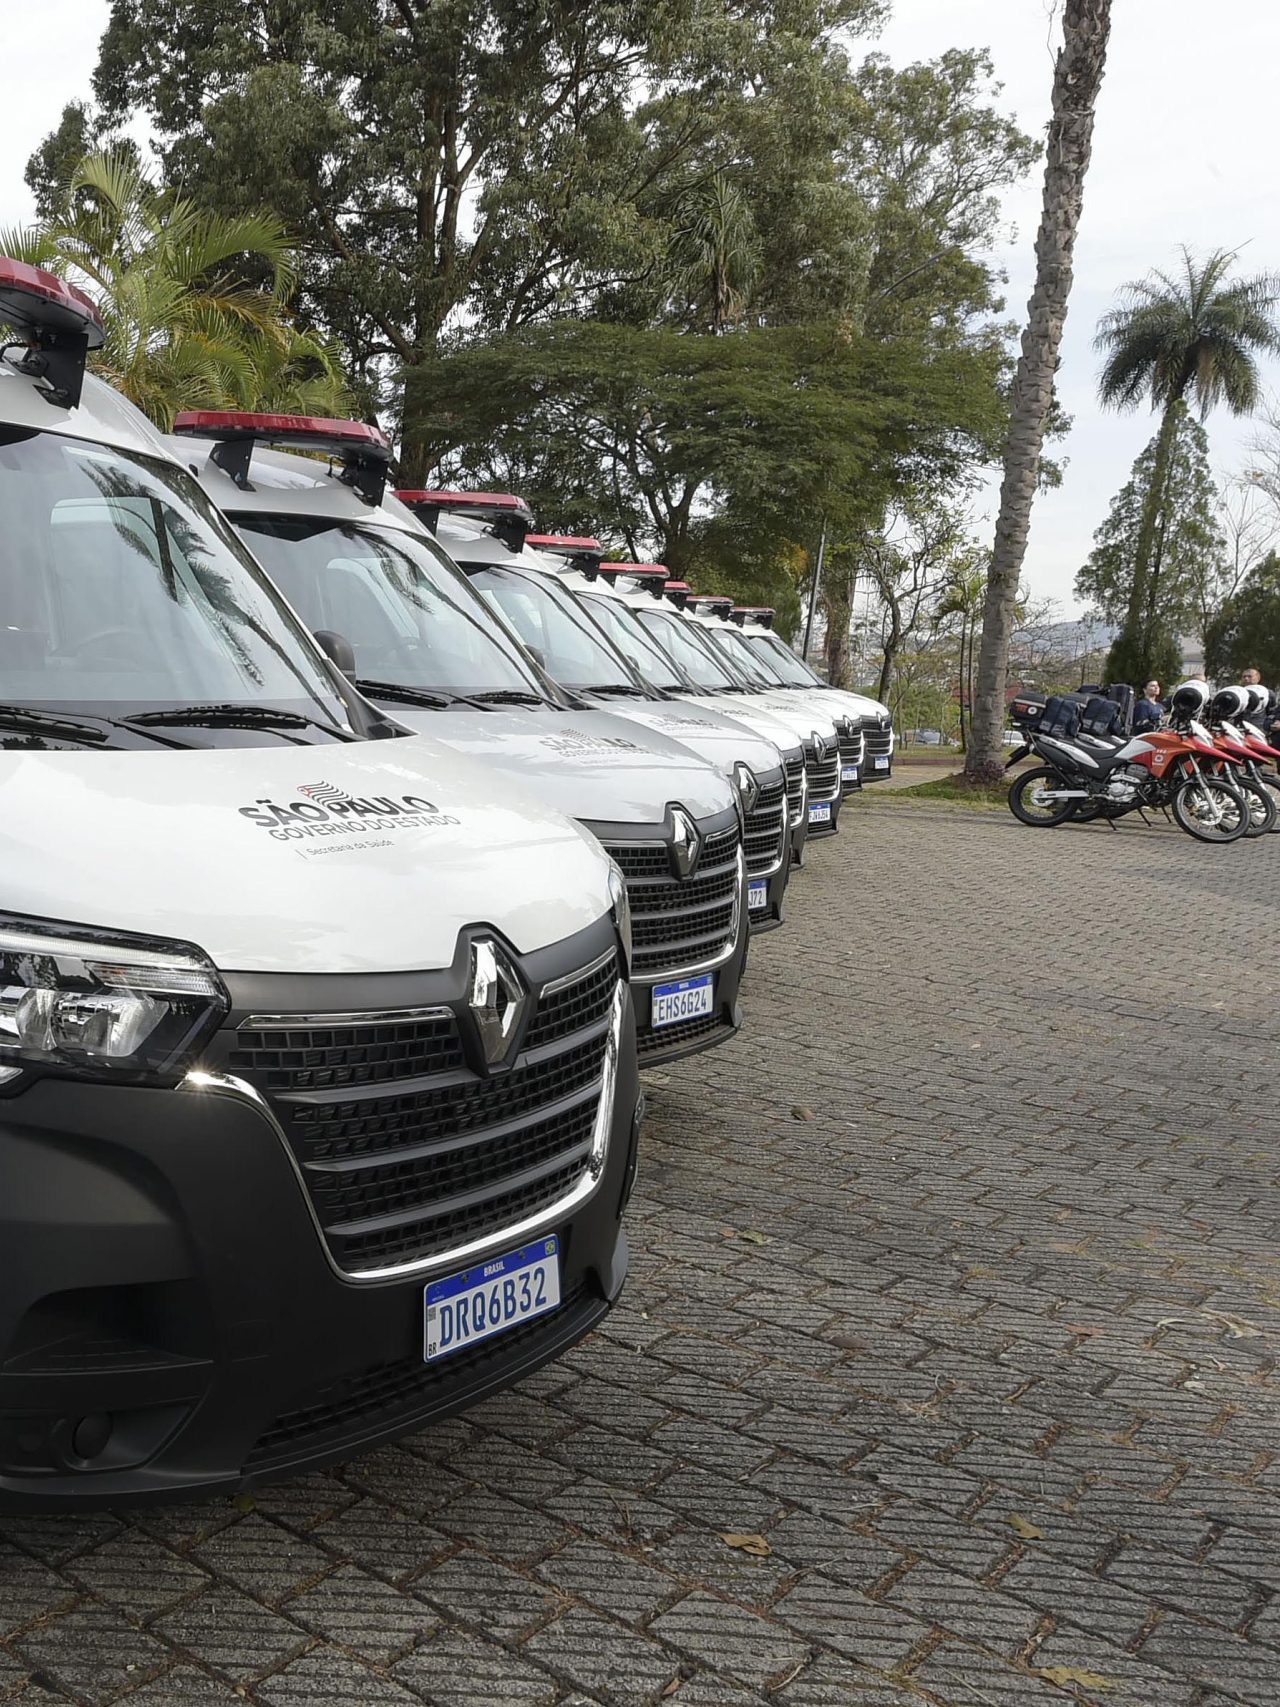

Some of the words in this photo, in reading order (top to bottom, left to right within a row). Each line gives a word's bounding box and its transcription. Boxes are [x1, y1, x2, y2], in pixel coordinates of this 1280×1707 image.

[238, 799, 330, 827] SÃO
[326, 796, 440, 819] PAULO
[268, 821, 367, 841] GOVERNO
[361, 818, 396, 830] DO
[390, 815, 461, 828] ESTADO
[483, 1260, 505, 1277] BRASIL
[439, 1266, 547, 1348] DRQ6B32
[428, 1342, 437, 1357] BR
